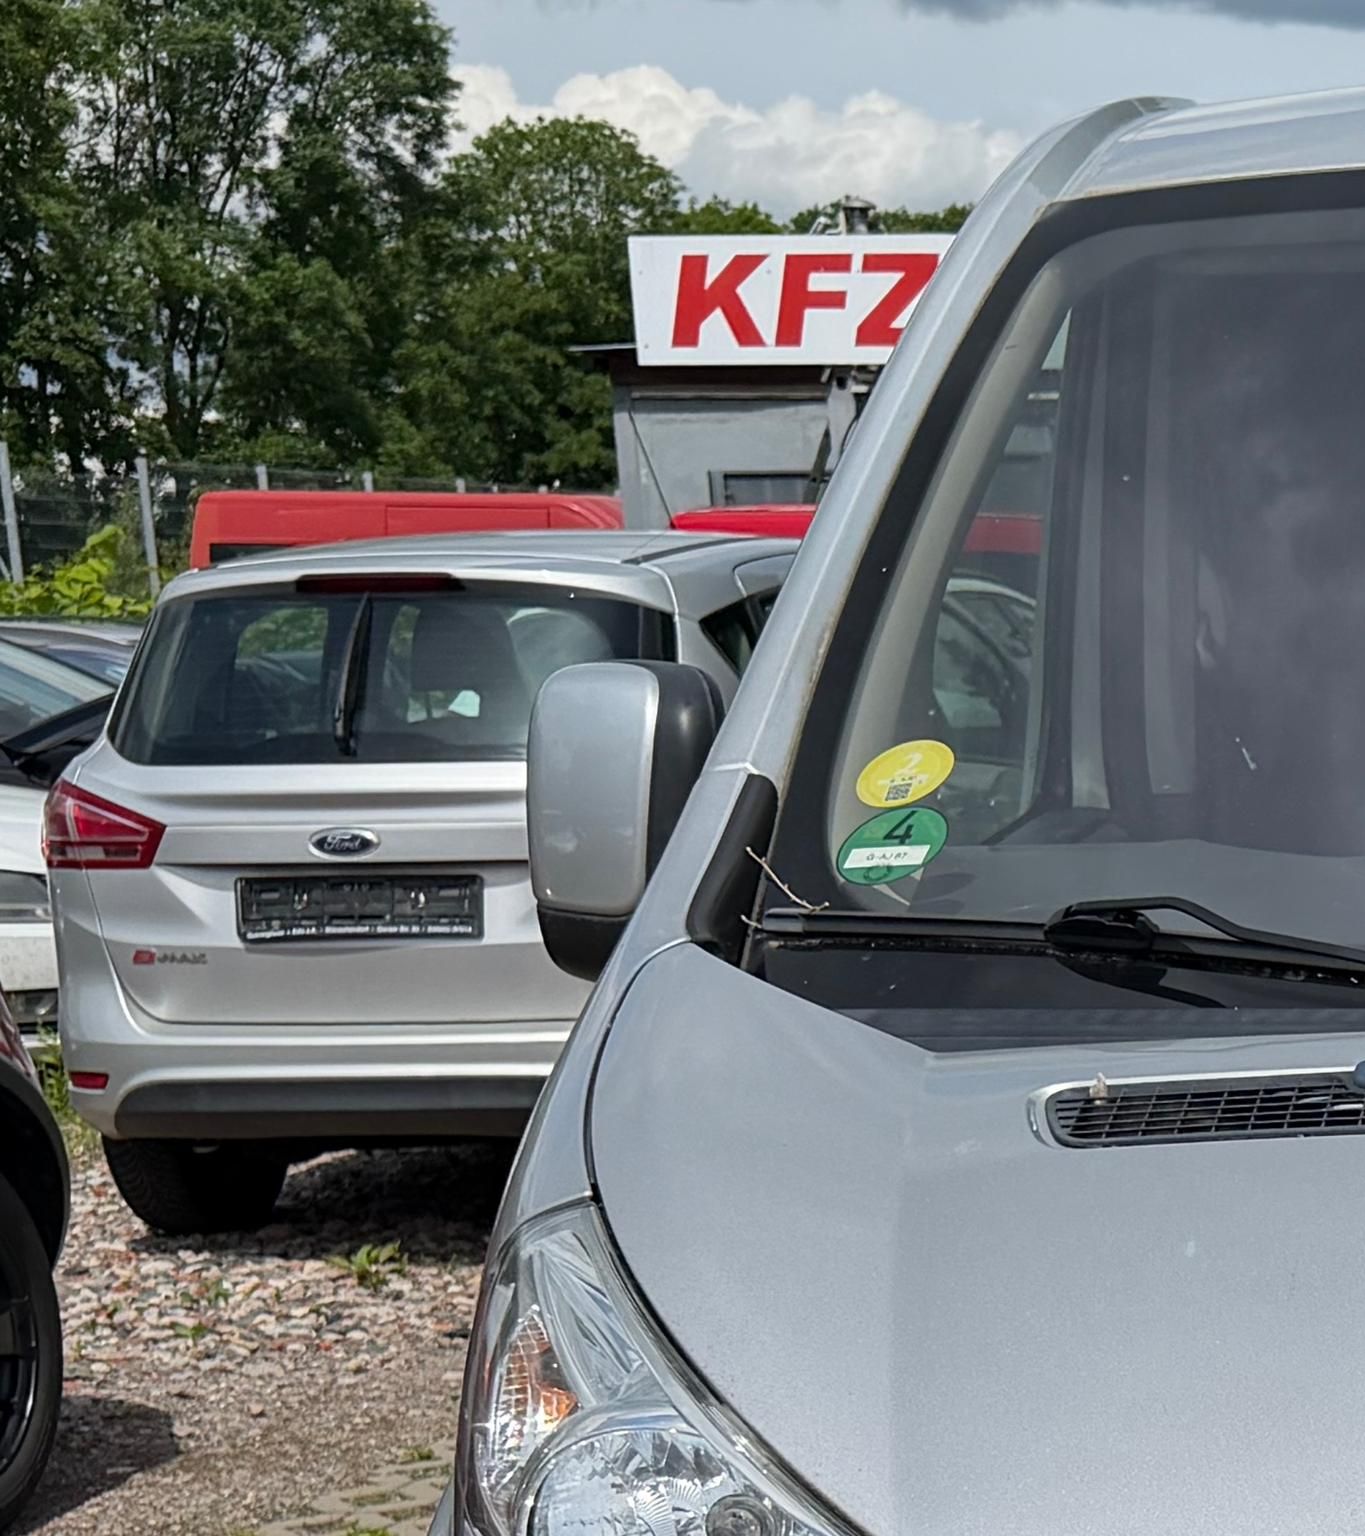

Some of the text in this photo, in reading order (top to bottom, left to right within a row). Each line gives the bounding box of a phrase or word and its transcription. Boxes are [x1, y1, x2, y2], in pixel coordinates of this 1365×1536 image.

[672, 254, 939, 348] KFZ
[324, 831, 361, 850] Ford
[883, 810, 918, 845] 4
